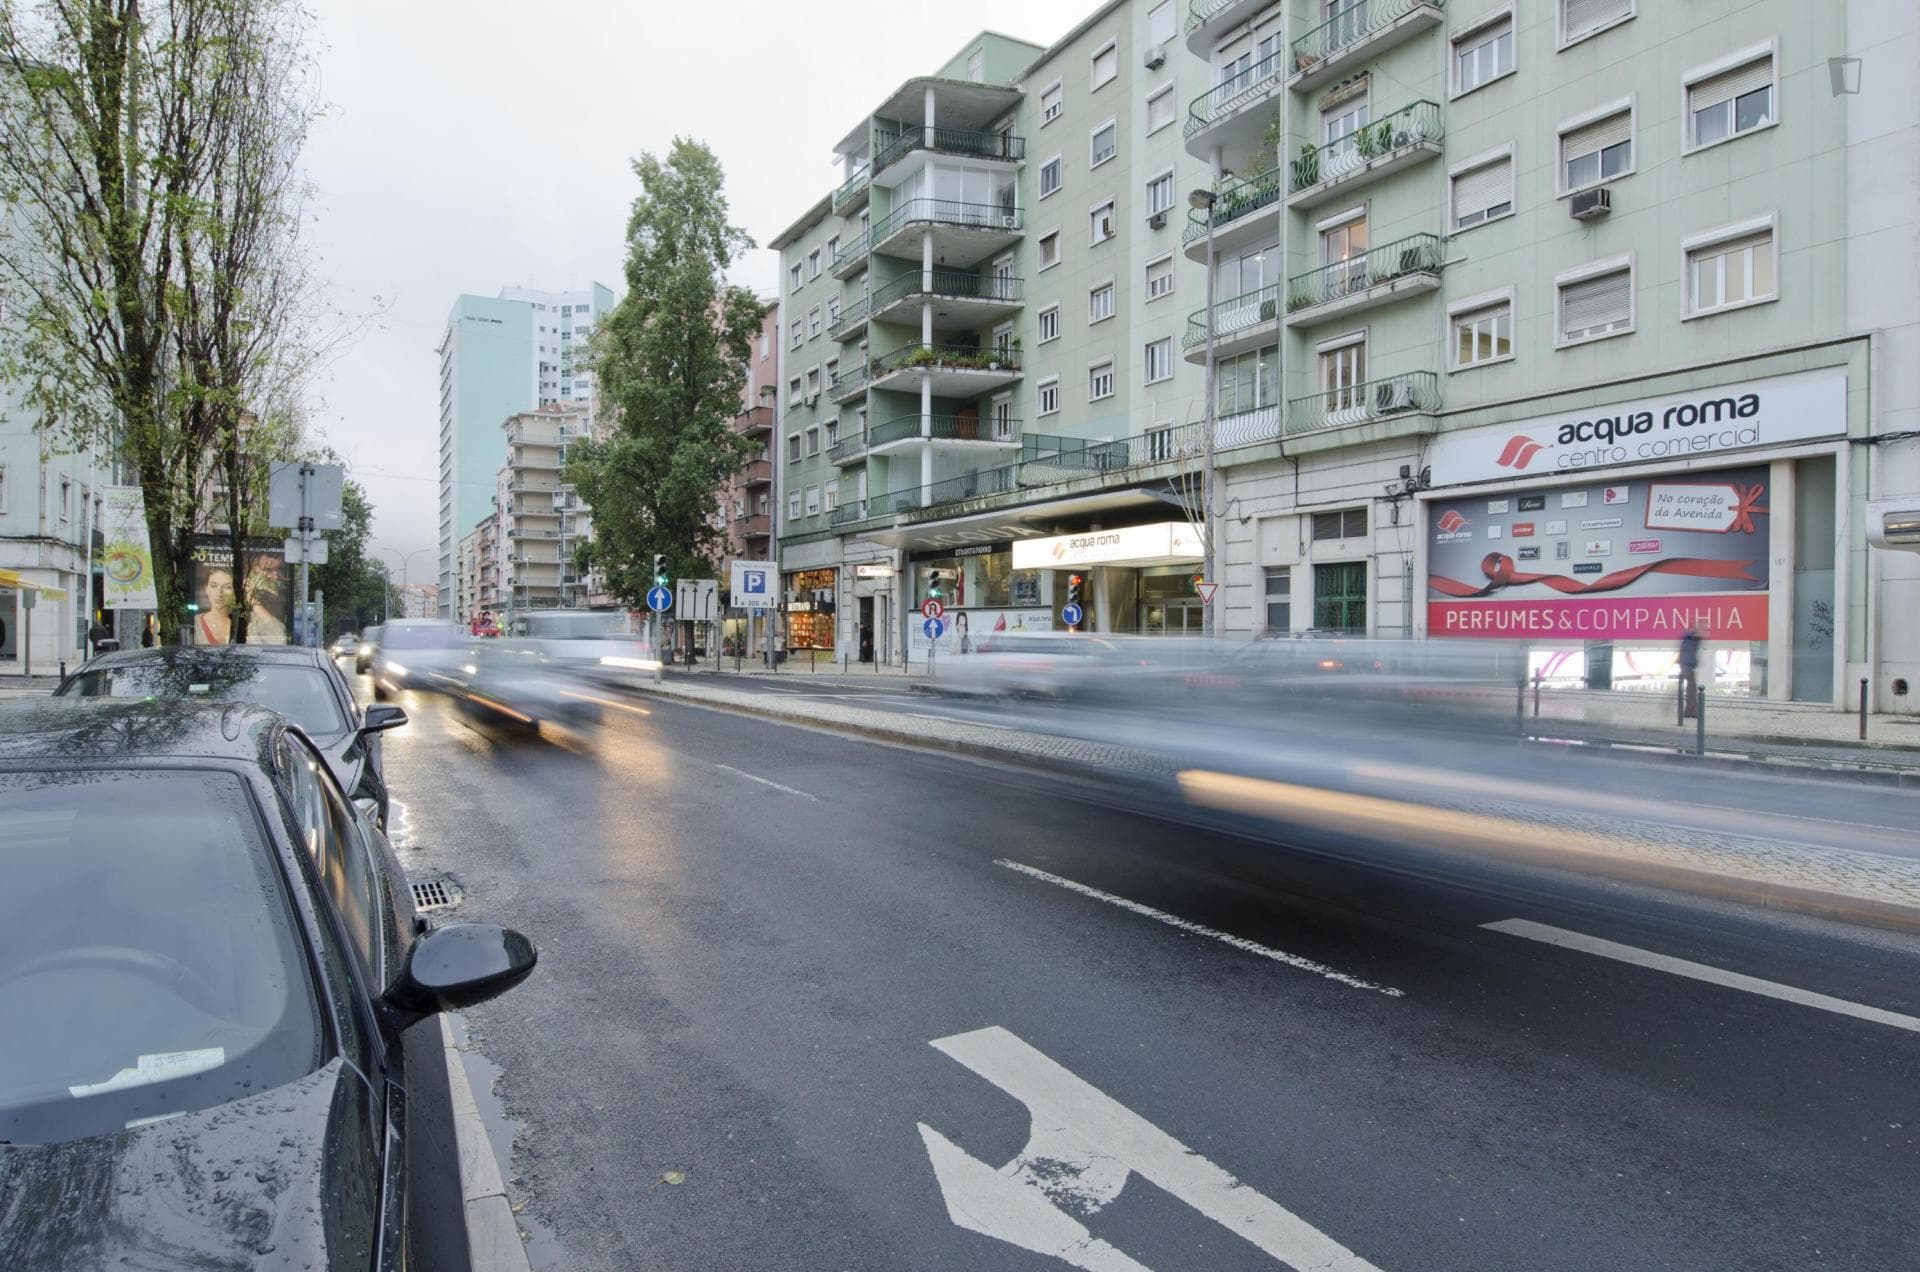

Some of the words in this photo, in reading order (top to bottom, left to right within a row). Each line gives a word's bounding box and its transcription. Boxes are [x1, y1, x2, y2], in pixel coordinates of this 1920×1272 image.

[1558, 411, 1653, 445] acqua
[1663, 393, 1760, 430] roma
[1557, 445, 1627, 469] centro
[1637, 421, 1760, 458] comercial
[1657, 493, 1674, 504] No
[1677, 494, 1724, 507] coração
[1654, 507, 1670, 517] da
[1674, 507, 1723, 520] Avenida
[1070, 537, 1096, 550] acqua
[1096, 533, 1121, 546] roma
[1446, 606, 1744, 631] PERFUMES&COMPANHIA
